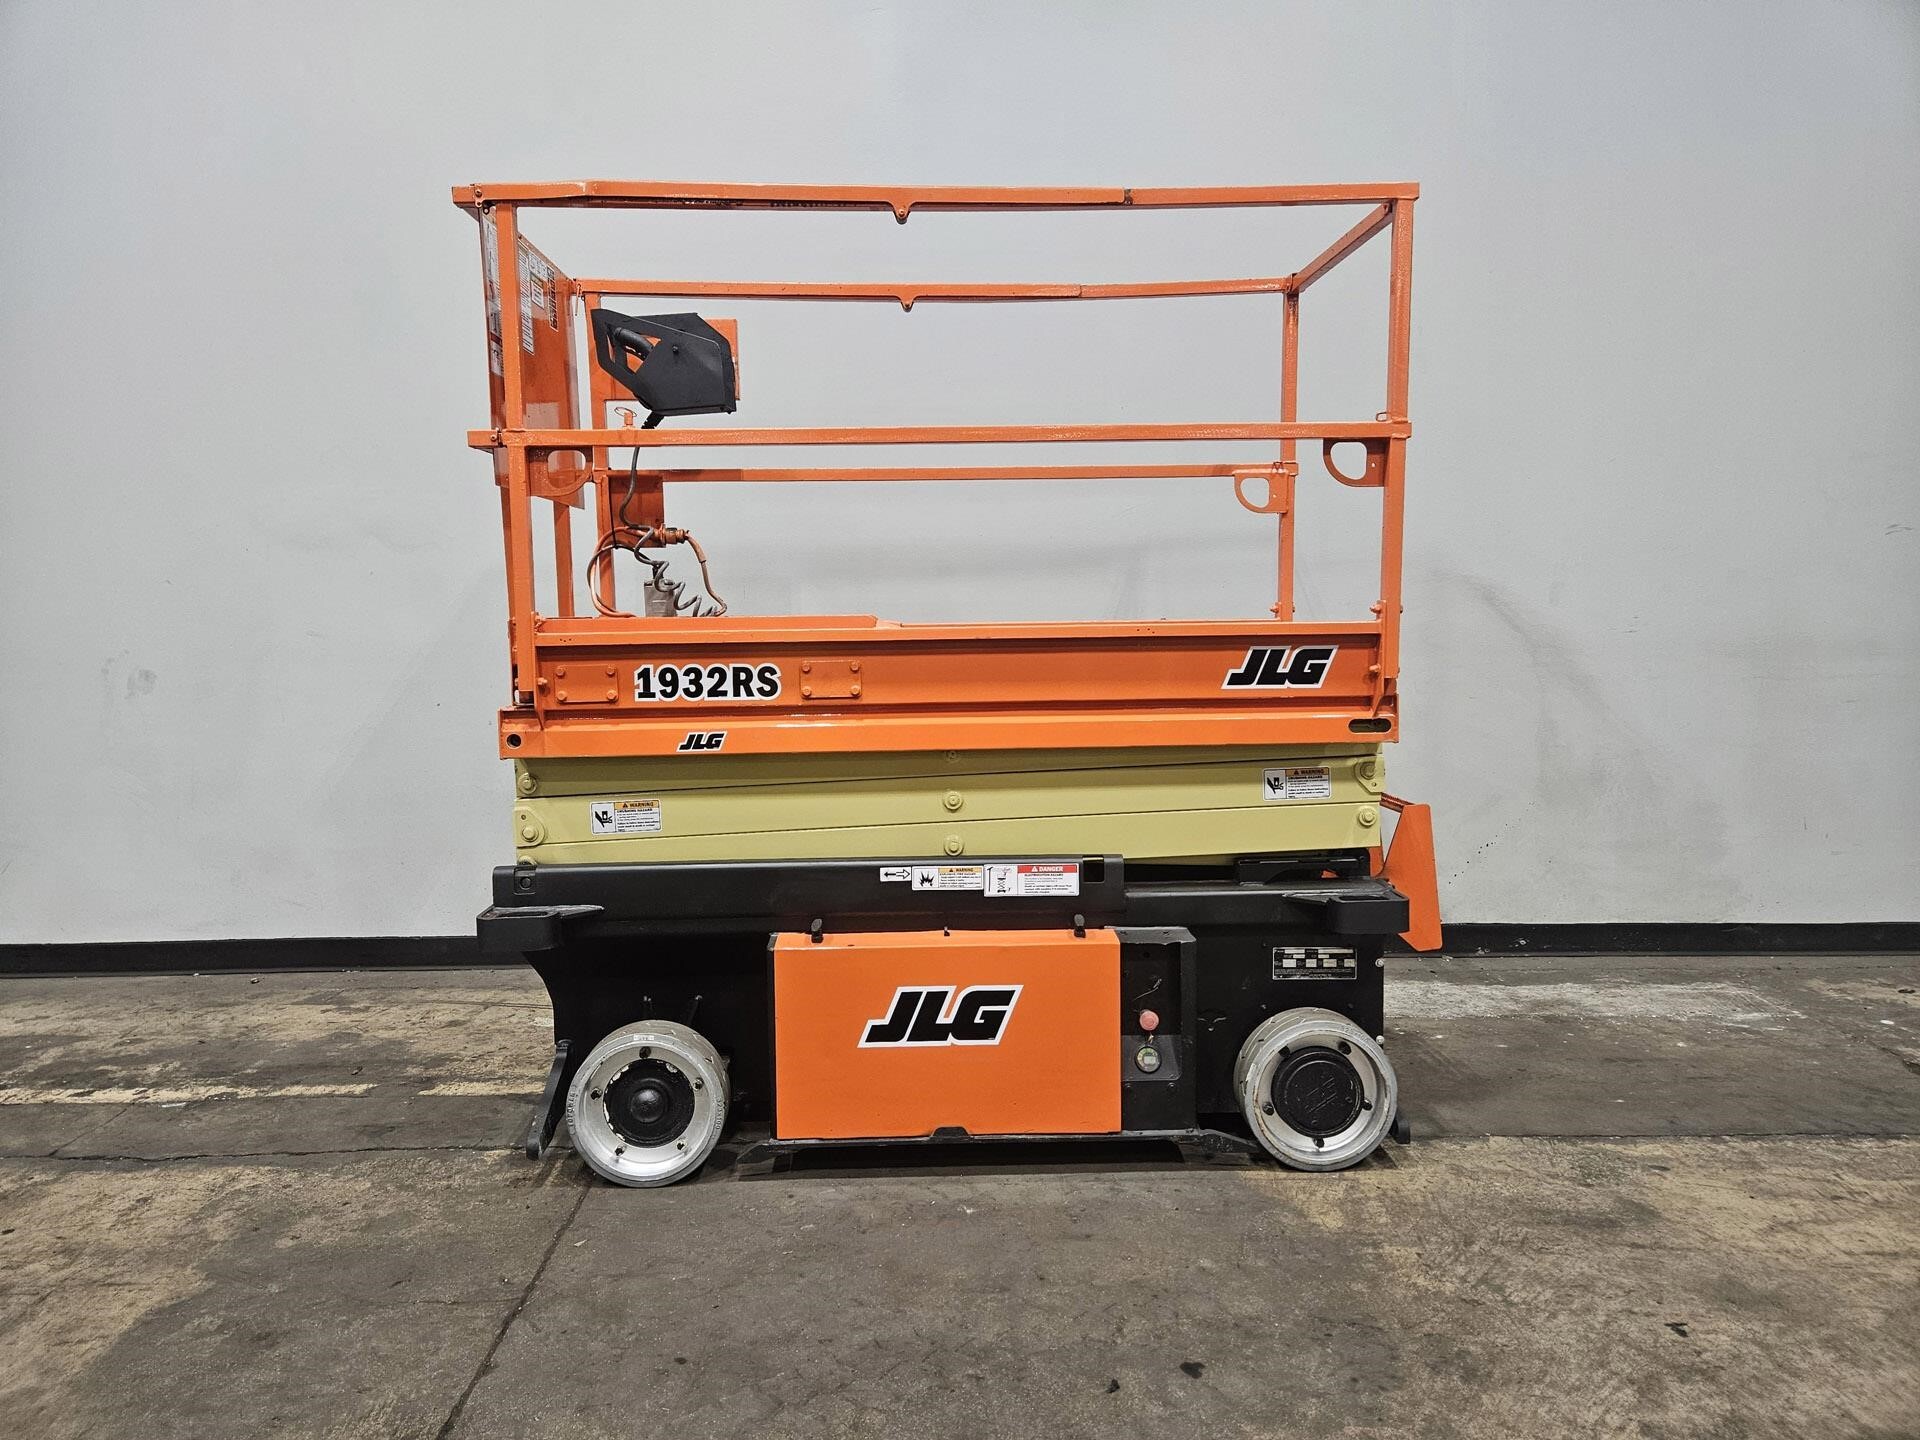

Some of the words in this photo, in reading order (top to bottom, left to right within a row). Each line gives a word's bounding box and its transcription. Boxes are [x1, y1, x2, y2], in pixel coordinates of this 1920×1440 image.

[636, 665, 779, 699] 1932RS
[1225, 647, 1336, 687] JLG
[678, 732, 726, 751] JLG
[862, 988, 1019, 1045] JLG
